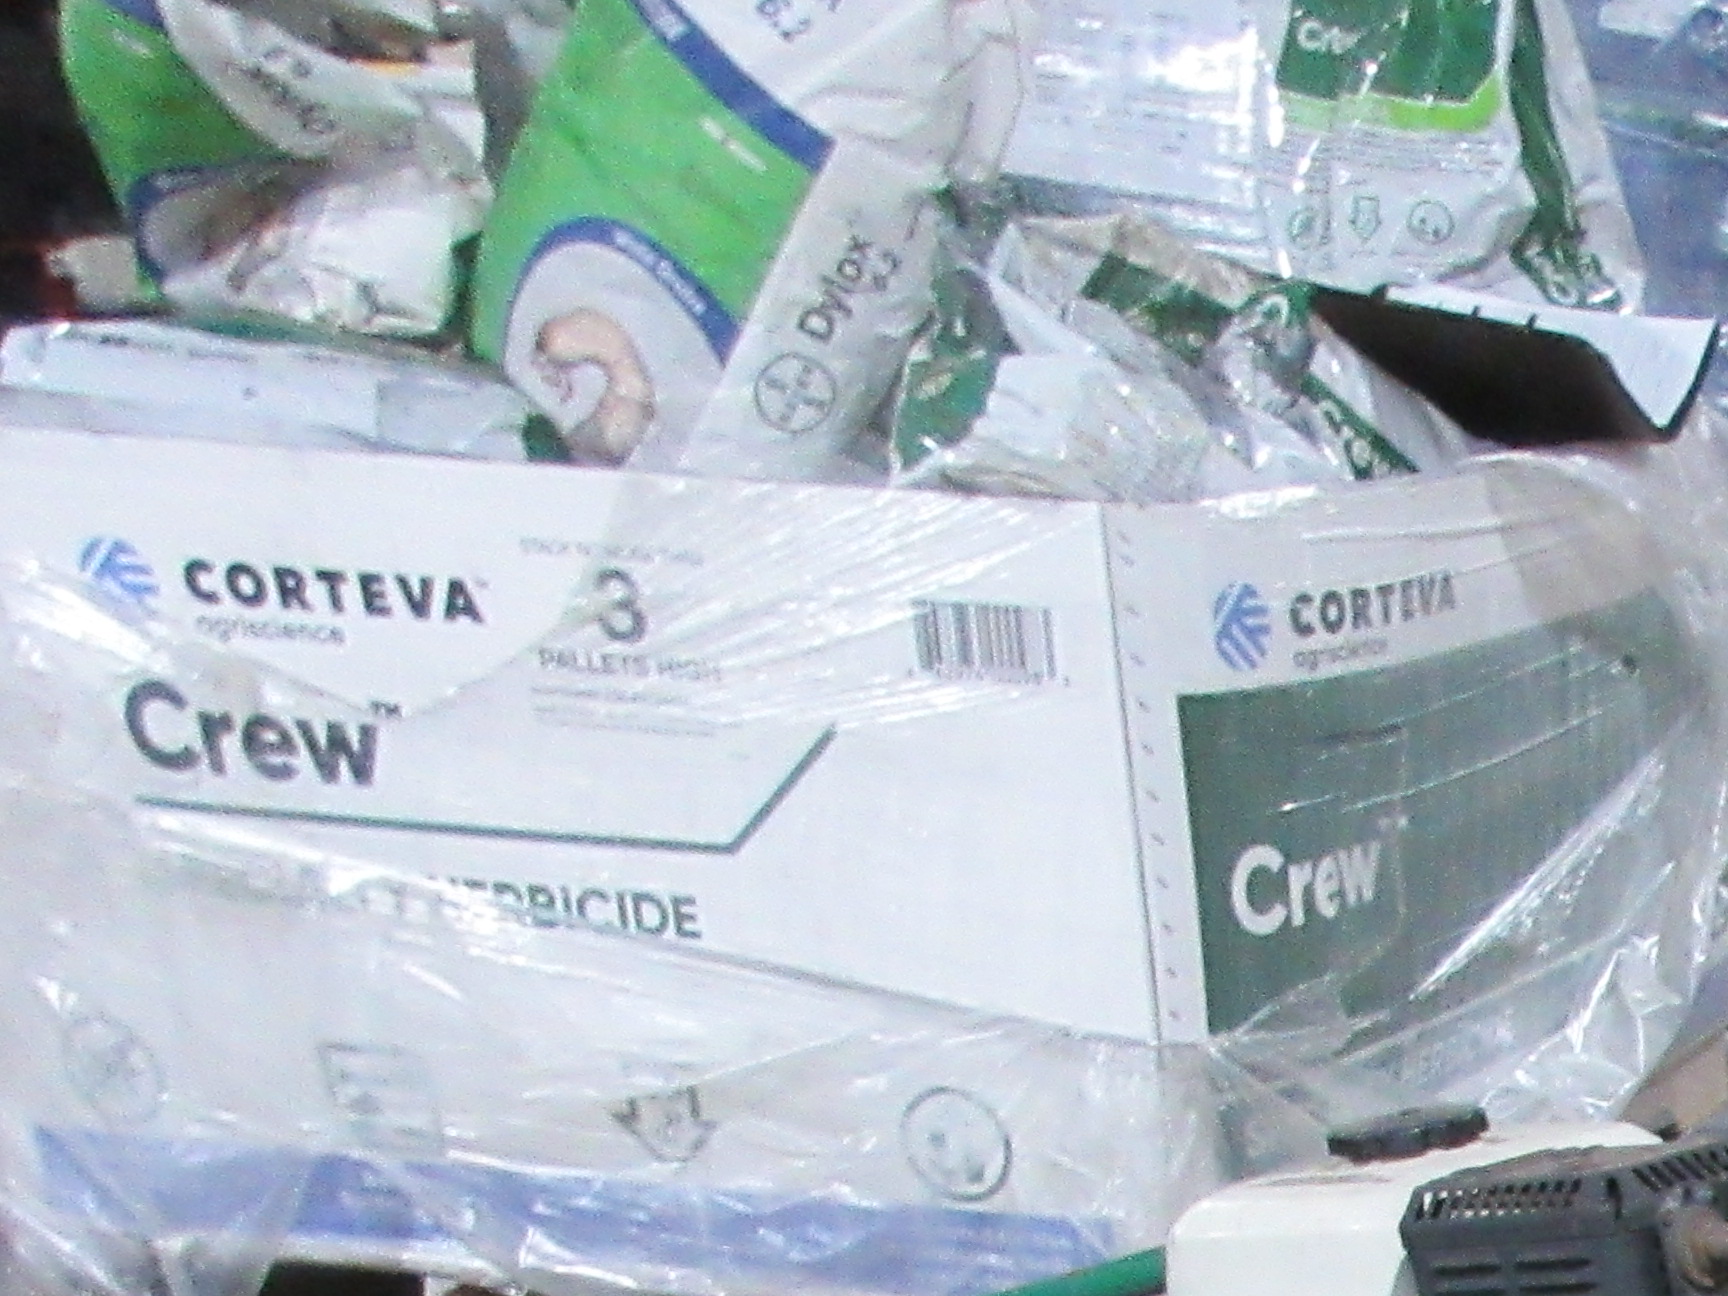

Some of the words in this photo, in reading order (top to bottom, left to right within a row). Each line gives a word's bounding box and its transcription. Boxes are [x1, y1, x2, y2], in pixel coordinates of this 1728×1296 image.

[797, 233, 873, 346] Dylox
[183, 557, 486, 625] CORTEVA
[594, 566, 648, 644] 3
[1289, 568, 1457, 638] CORTEVA
[538, 648, 651, 679] PALLETS
